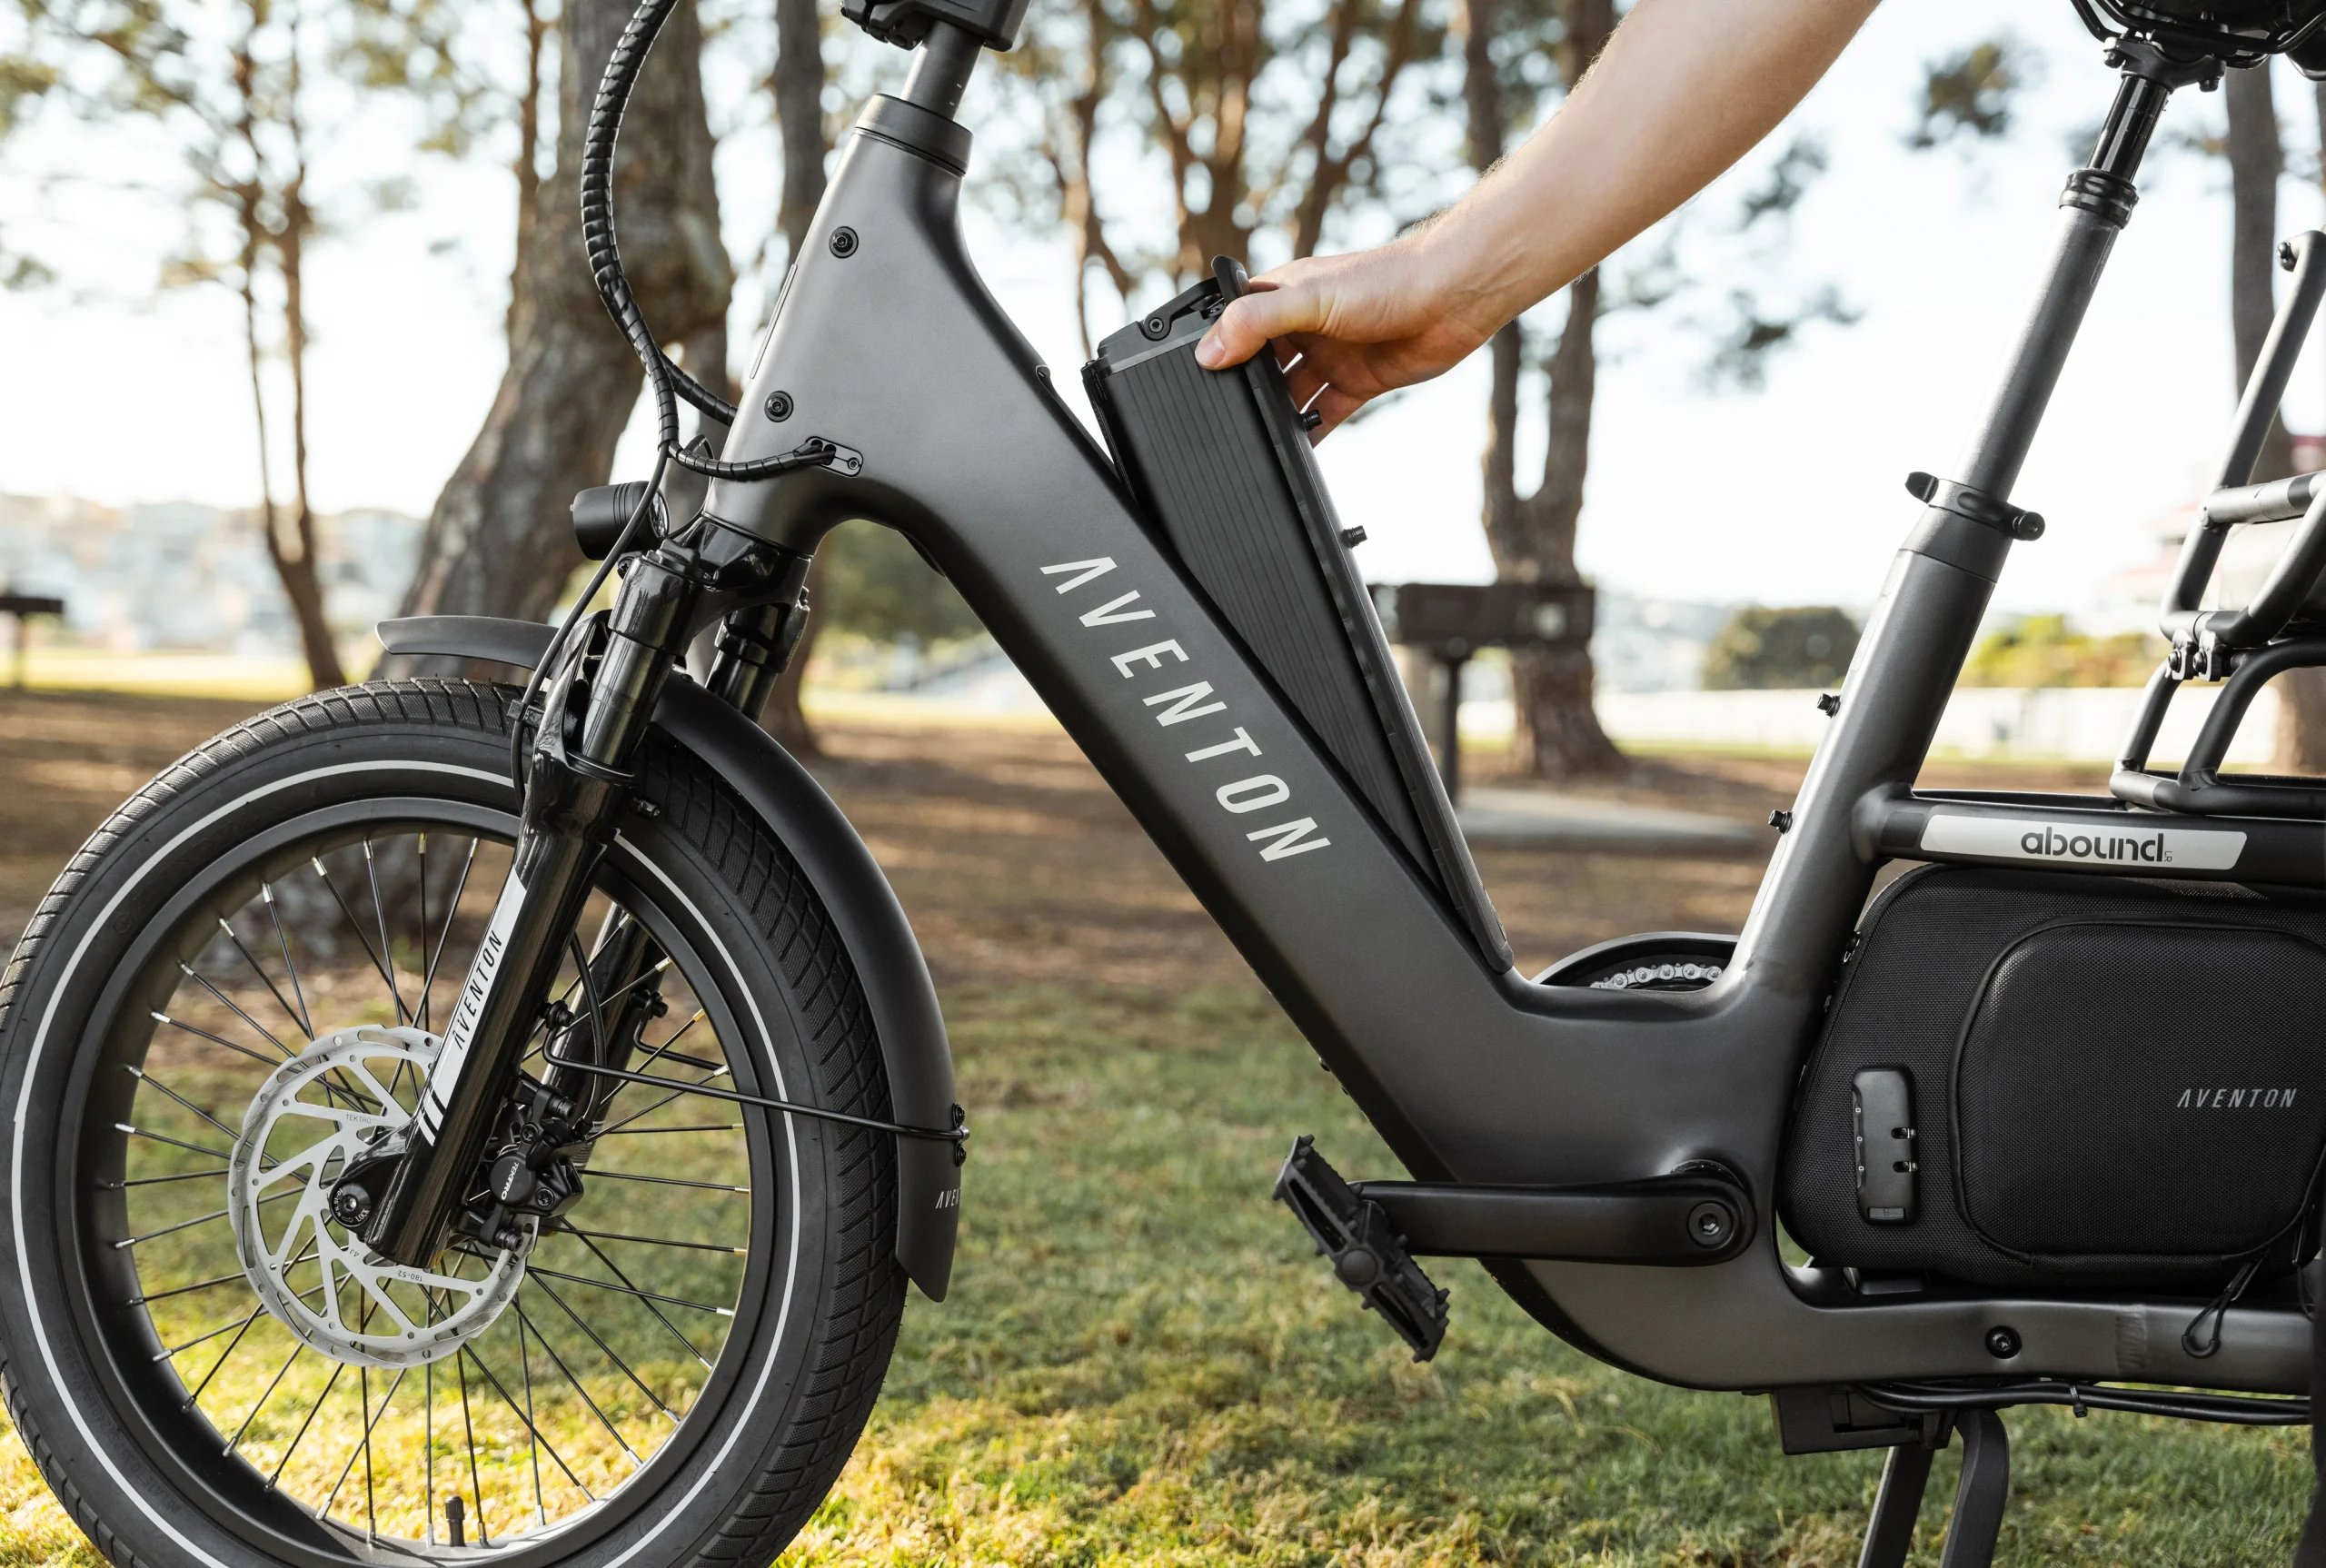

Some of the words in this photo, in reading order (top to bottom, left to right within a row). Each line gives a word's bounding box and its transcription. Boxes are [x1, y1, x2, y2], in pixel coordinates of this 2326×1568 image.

[1039, 556, 1331, 862] AVENTON
[2021, 826, 2163, 862] abound
[452, 930, 502, 1050] AVENTON
[2177, 1087, 2297, 1108] AVENTON
[346, 1113, 372, 1125] TEKTRO
[354, 1208, 370, 1222] LOCK
[397, 1269, 422, 1282] 180-52
